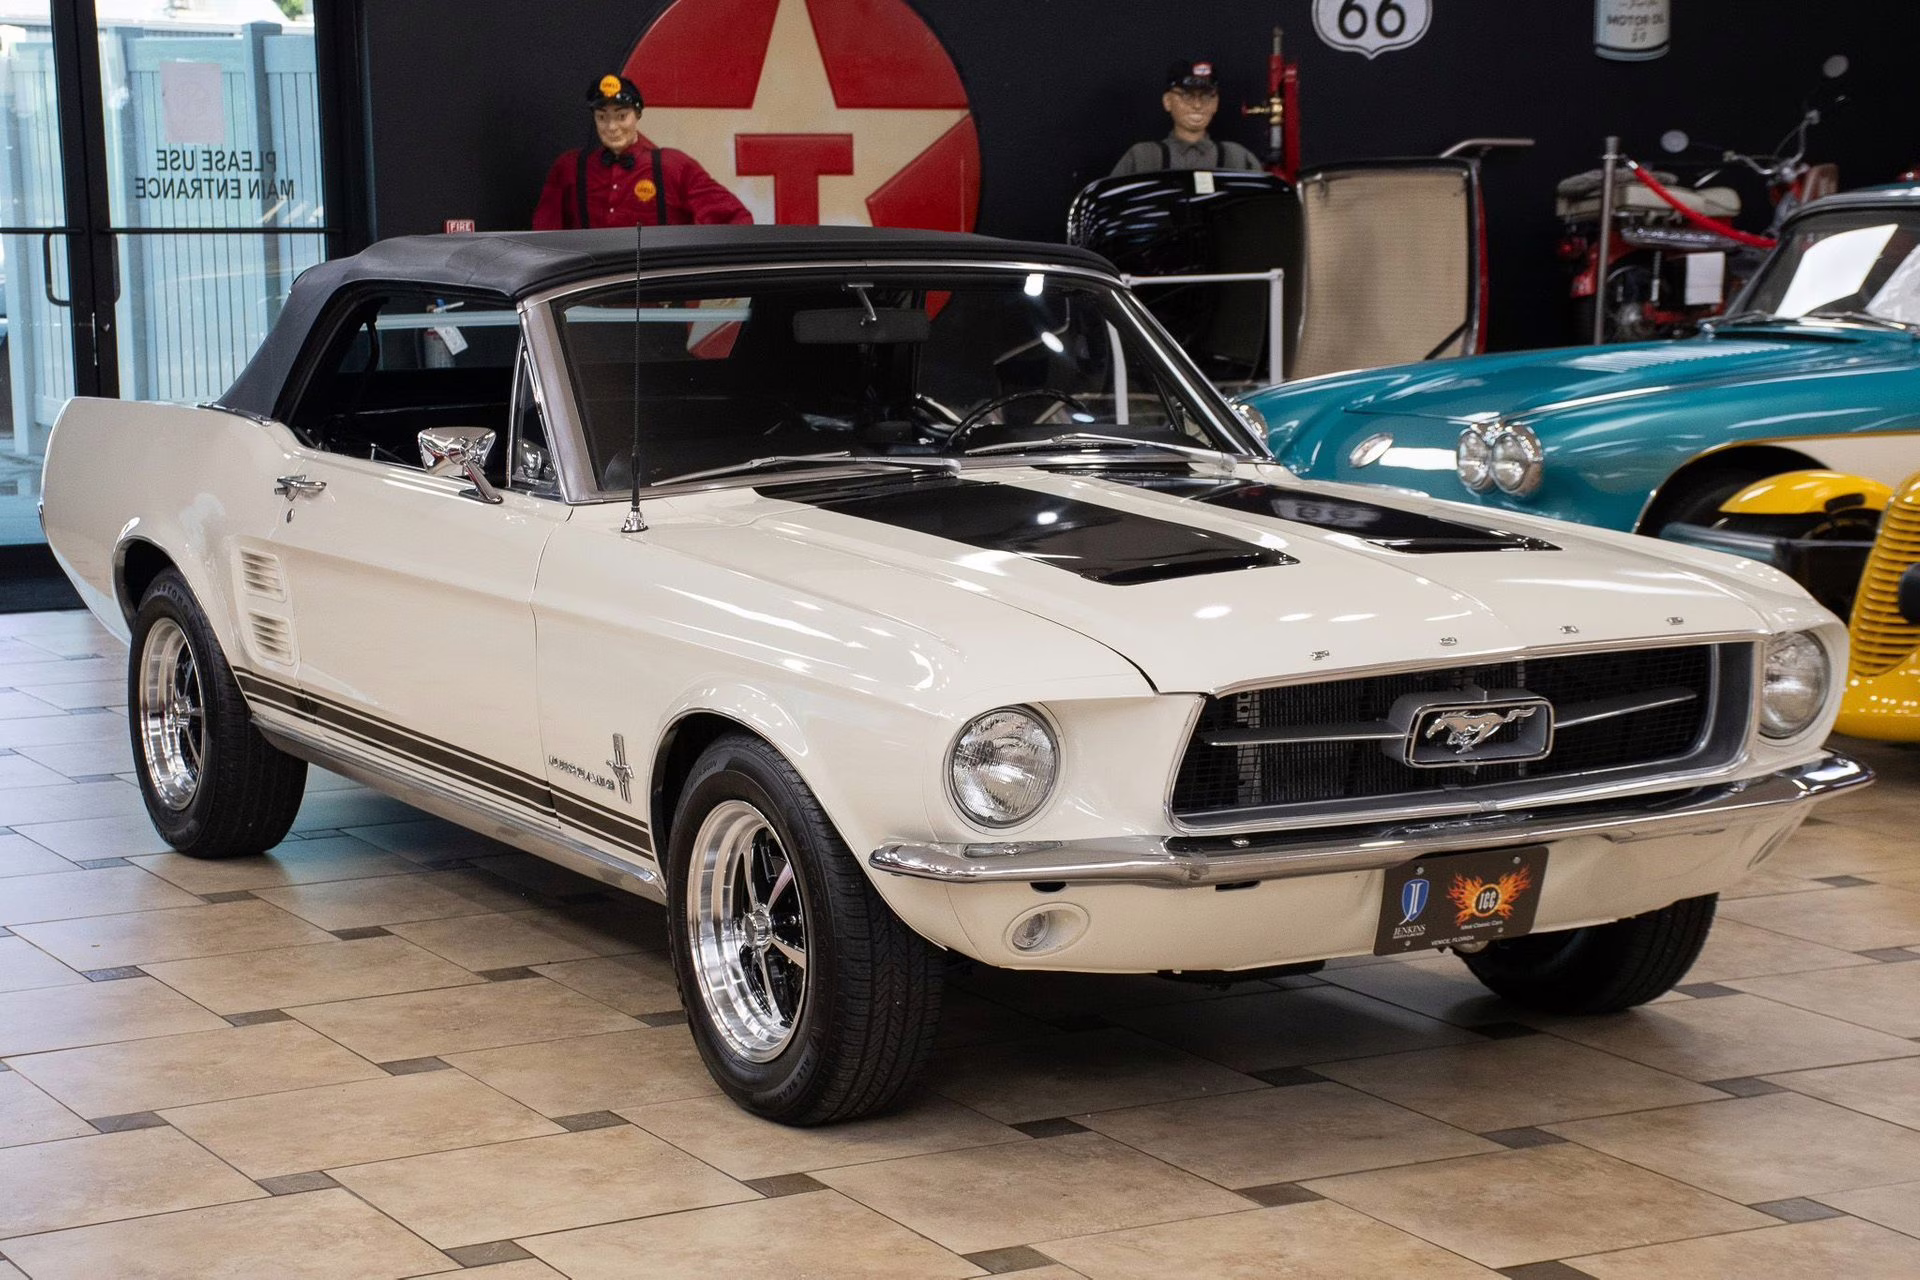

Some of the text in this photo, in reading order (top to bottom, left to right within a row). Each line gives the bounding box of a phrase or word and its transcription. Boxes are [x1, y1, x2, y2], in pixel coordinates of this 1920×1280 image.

[1338, 0, 1406, 39] 66
[735, 133, 853, 225] T
[1393, 924, 1426, 936] JENKINS
[1452, 935, 1475, 943] FLORIDA
